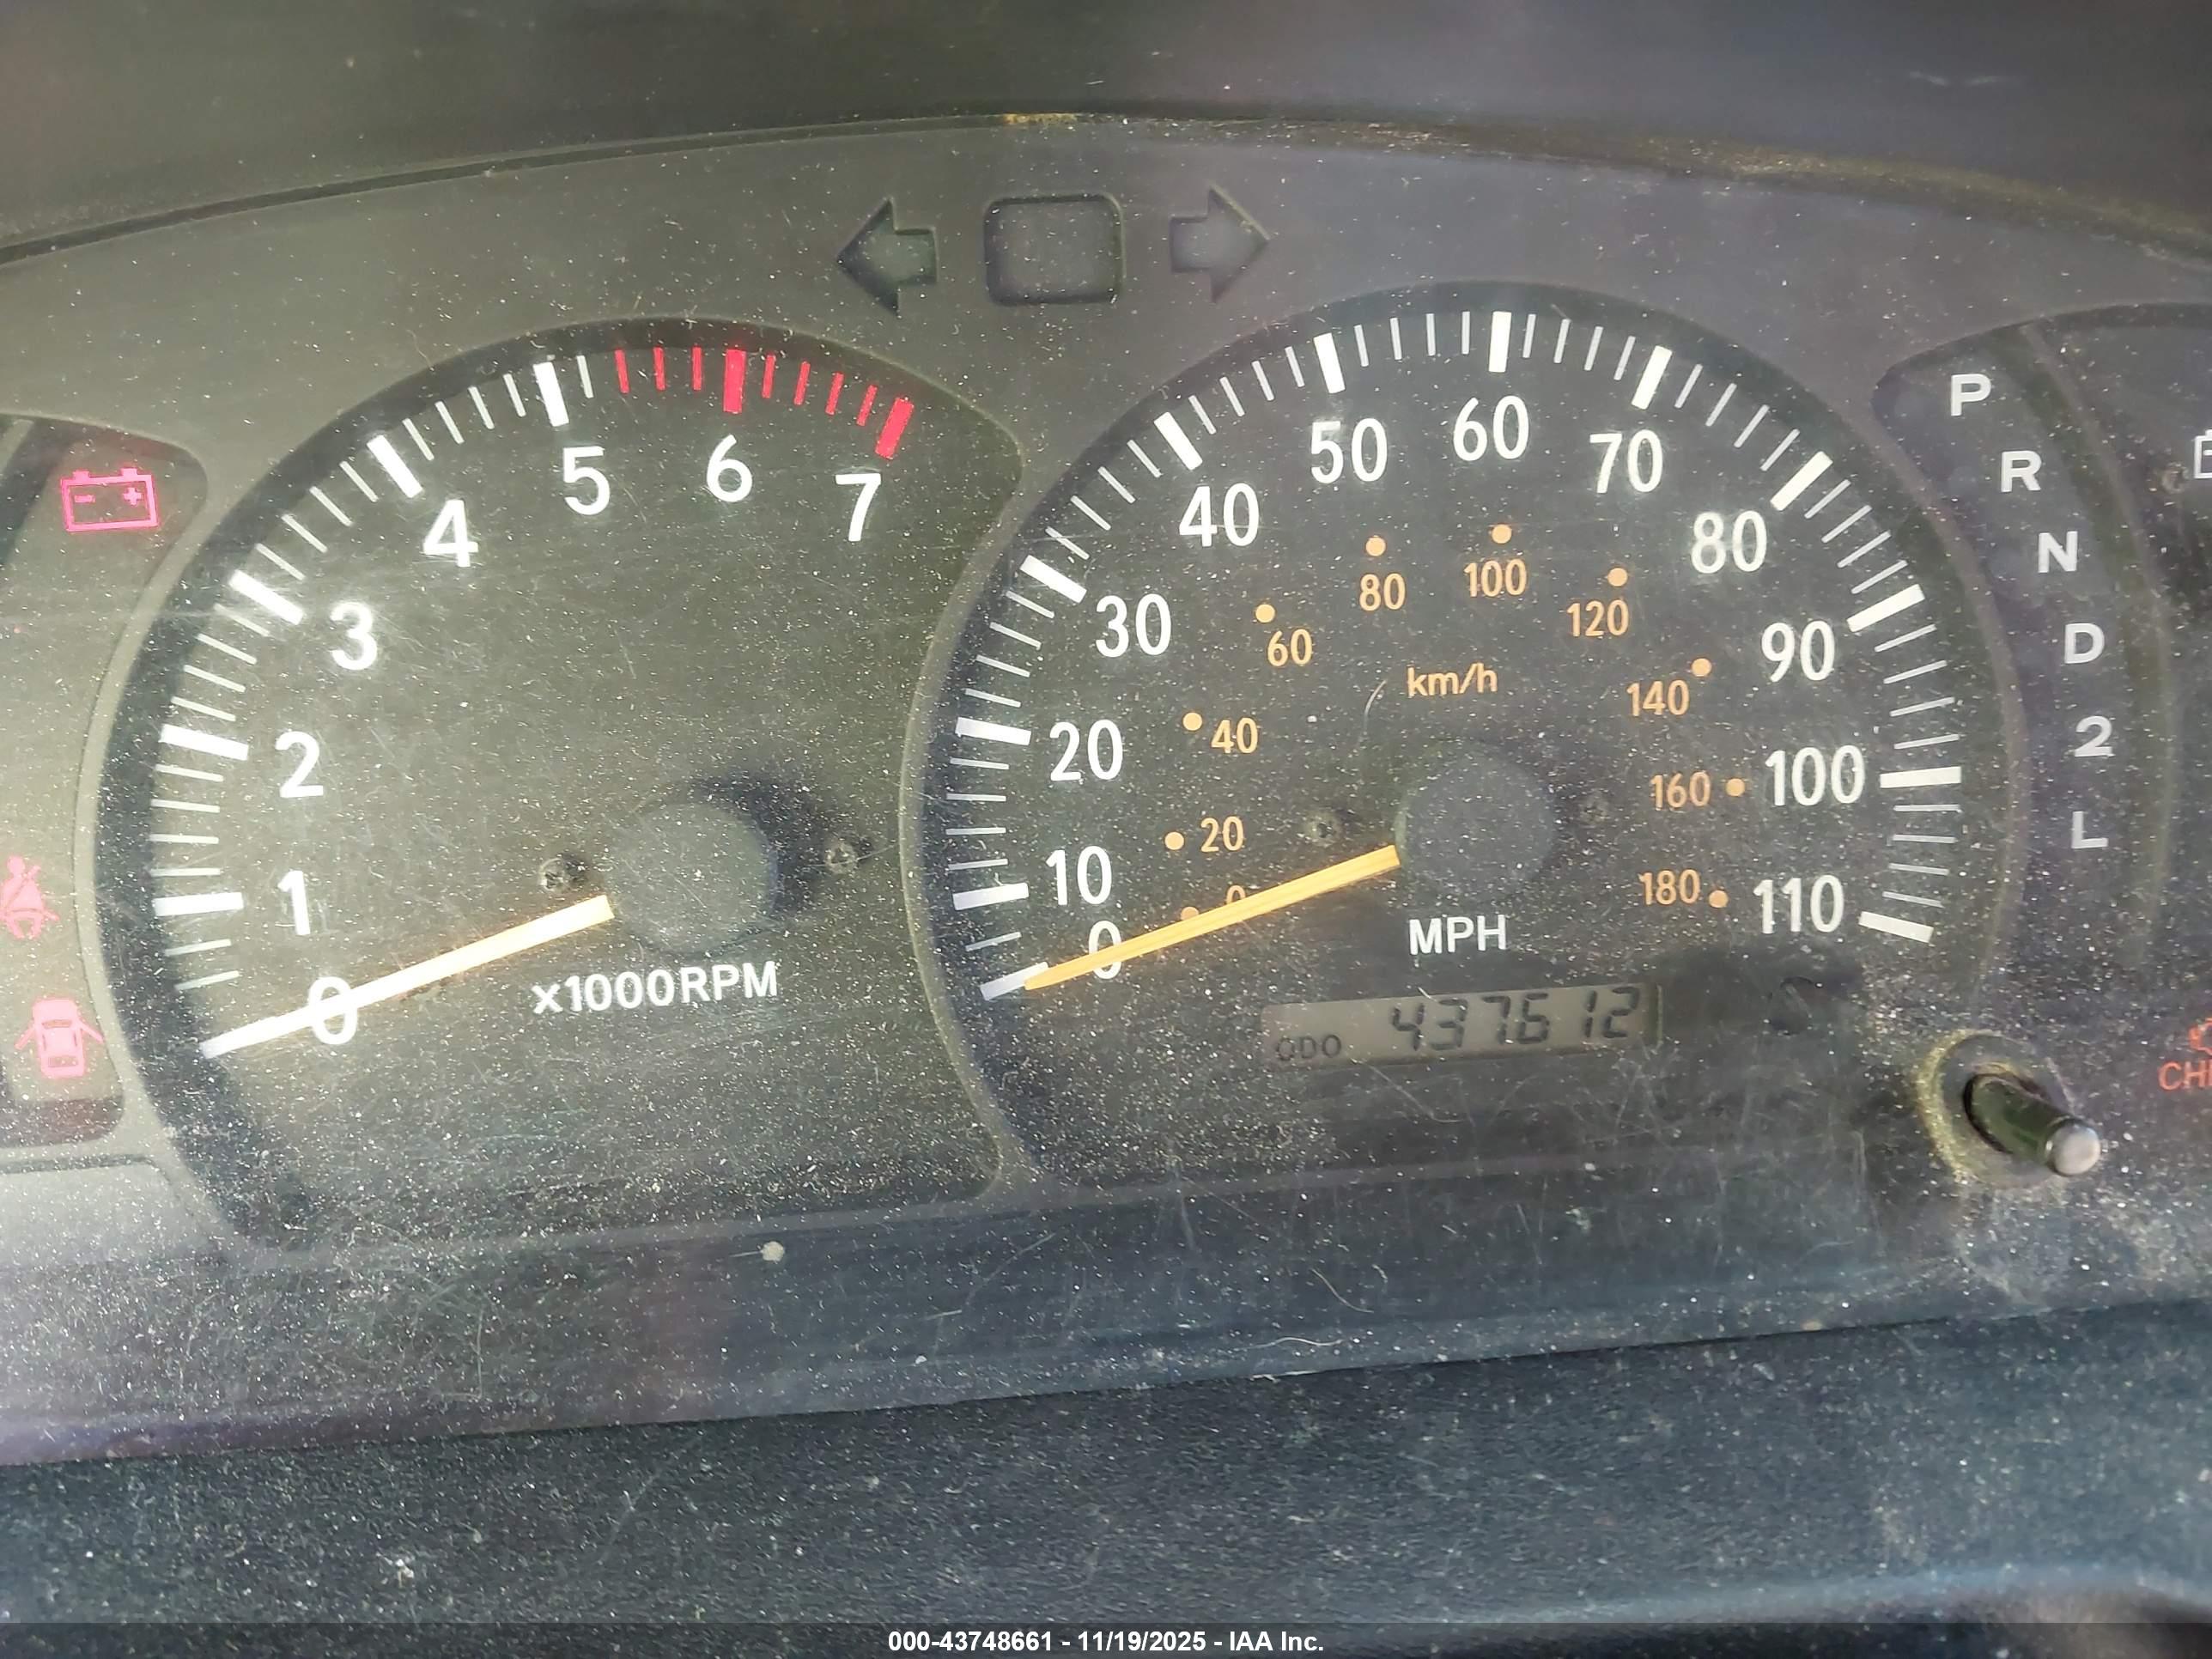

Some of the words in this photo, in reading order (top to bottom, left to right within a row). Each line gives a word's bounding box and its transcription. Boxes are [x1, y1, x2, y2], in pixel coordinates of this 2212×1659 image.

[1950, 374, 1992, 416] P
[1310, 418, 1387, 483] 50
[1453, 396, 1528, 461] 60
[562, 446, 611, 515] 5
[706, 434, 752, 501] 6
[1589, 430, 1662, 493] 70
[2001, 450, 2042, 493] R
[422, 500, 478, 568] 4
[836, 473, 881, 541] 7
[1179, 483, 1259, 547] 40
[1692, 511, 1767, 574] 80
[2038, 531, 2078, 573] N
[1359, 574, 1406, 611] 80
[1464, 559, 1527, 598] 100
[331, 603, 378, 670] 3
[1096, 594, 1171, 657] 30
[1267, 629, 1312, 667] 60
[1567, 600, 1629, 637] 120
[2064, 623, 2106, 663] D
[1407, 663, 1498, 697] km/h
[1761, 621, 1835, 683] 90
[1627, 680, 1689, 716] 140
[276, 732, 324, 798] 2
[1049, 720, 1122, 781] 20
[1212, 717, 1258, 755] 40
[2074, 717, 2113, 758] 2
[1651, 771, 1711, 809] 160
[1765, 744, 1865, 806] 100
[1200, 816, 1244, 853] 20
[2071, 811, 2109, 849] L
[277, 871, 310, 936] 1
[1046, 846, 1112, 906] 10
[1639, 870, 1700, 905] 180
[1754, 875, 1844, 933] 110
[1088, 921, 1122, 980] 0
[1408, 915, 1507, 956] MPH
[308, 976, 358, 1044] 0
[1392, 986, 1640, 1051] 437612
[1275, 1034, 1342, 1060] ODO
